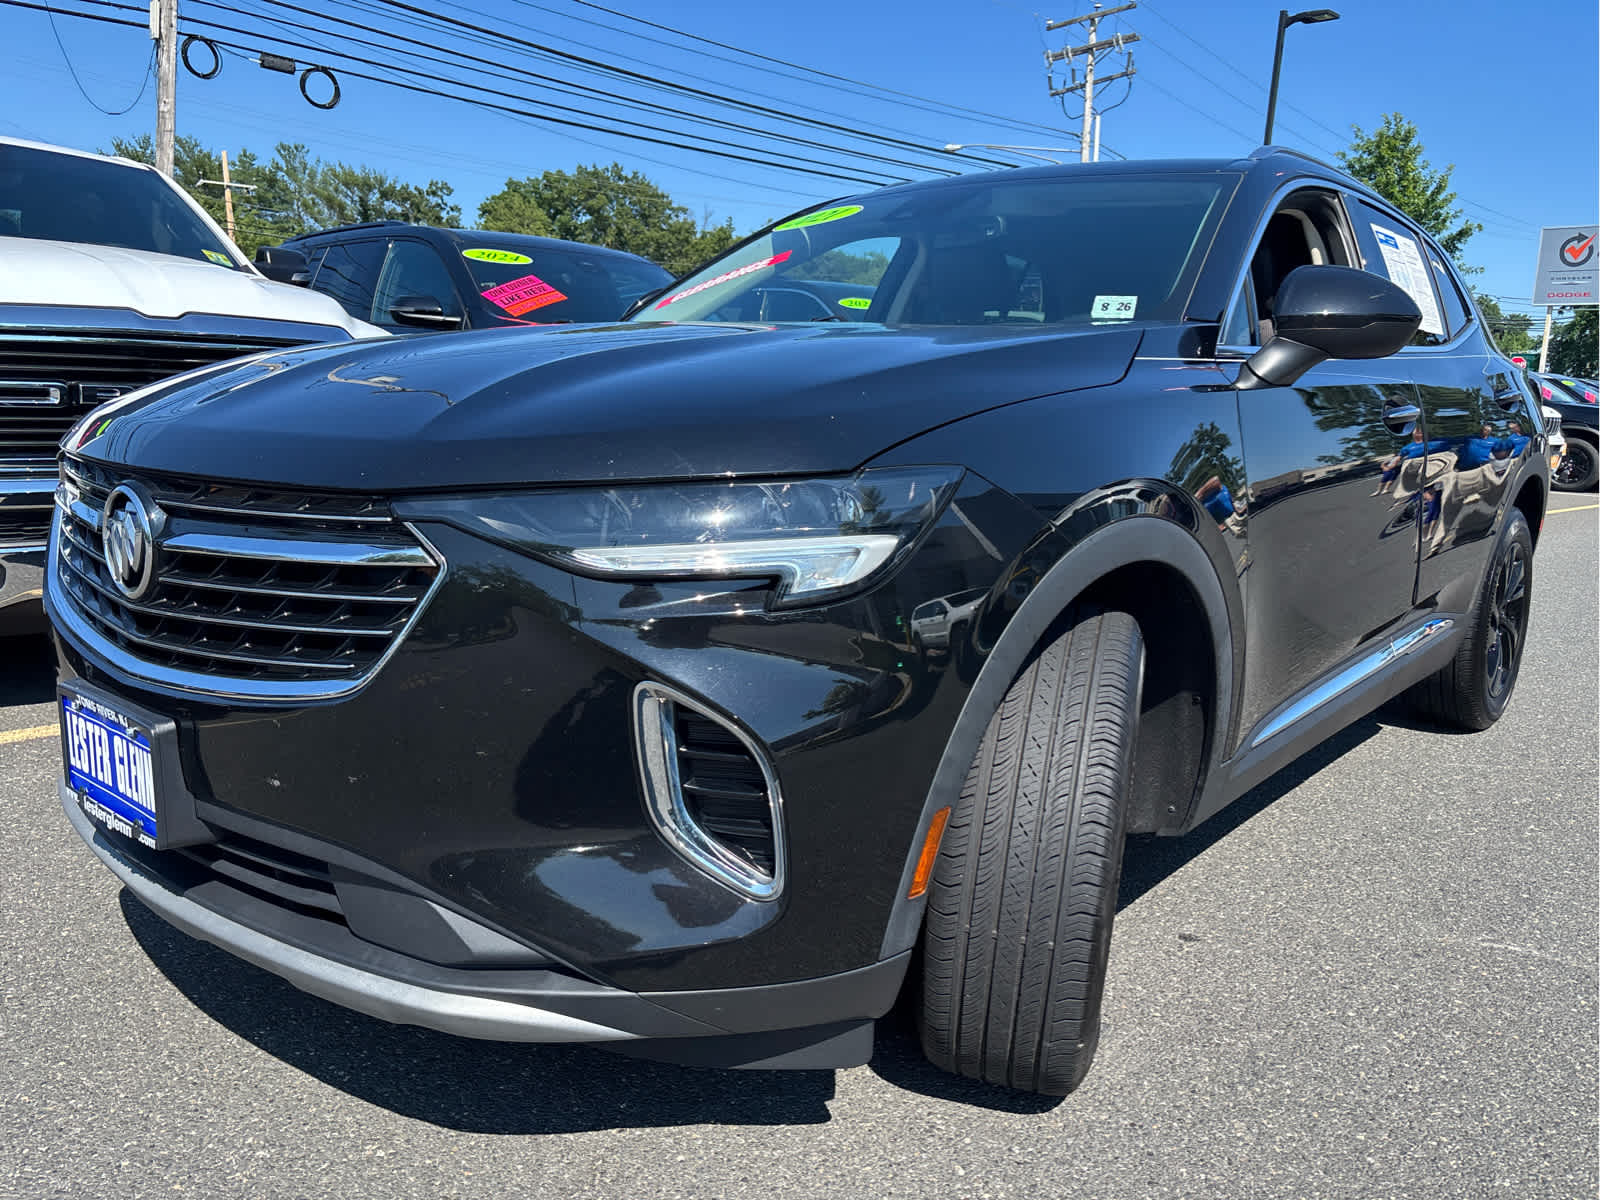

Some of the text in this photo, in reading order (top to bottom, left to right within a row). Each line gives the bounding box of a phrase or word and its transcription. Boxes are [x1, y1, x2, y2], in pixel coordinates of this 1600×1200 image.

[475, 251, 520, 261] 2024
[500, 294, 521, 305] LIKE
[1101, 302, 1132, 312] 8 26
[65, 711, 156, 814] LESTER GLENN
